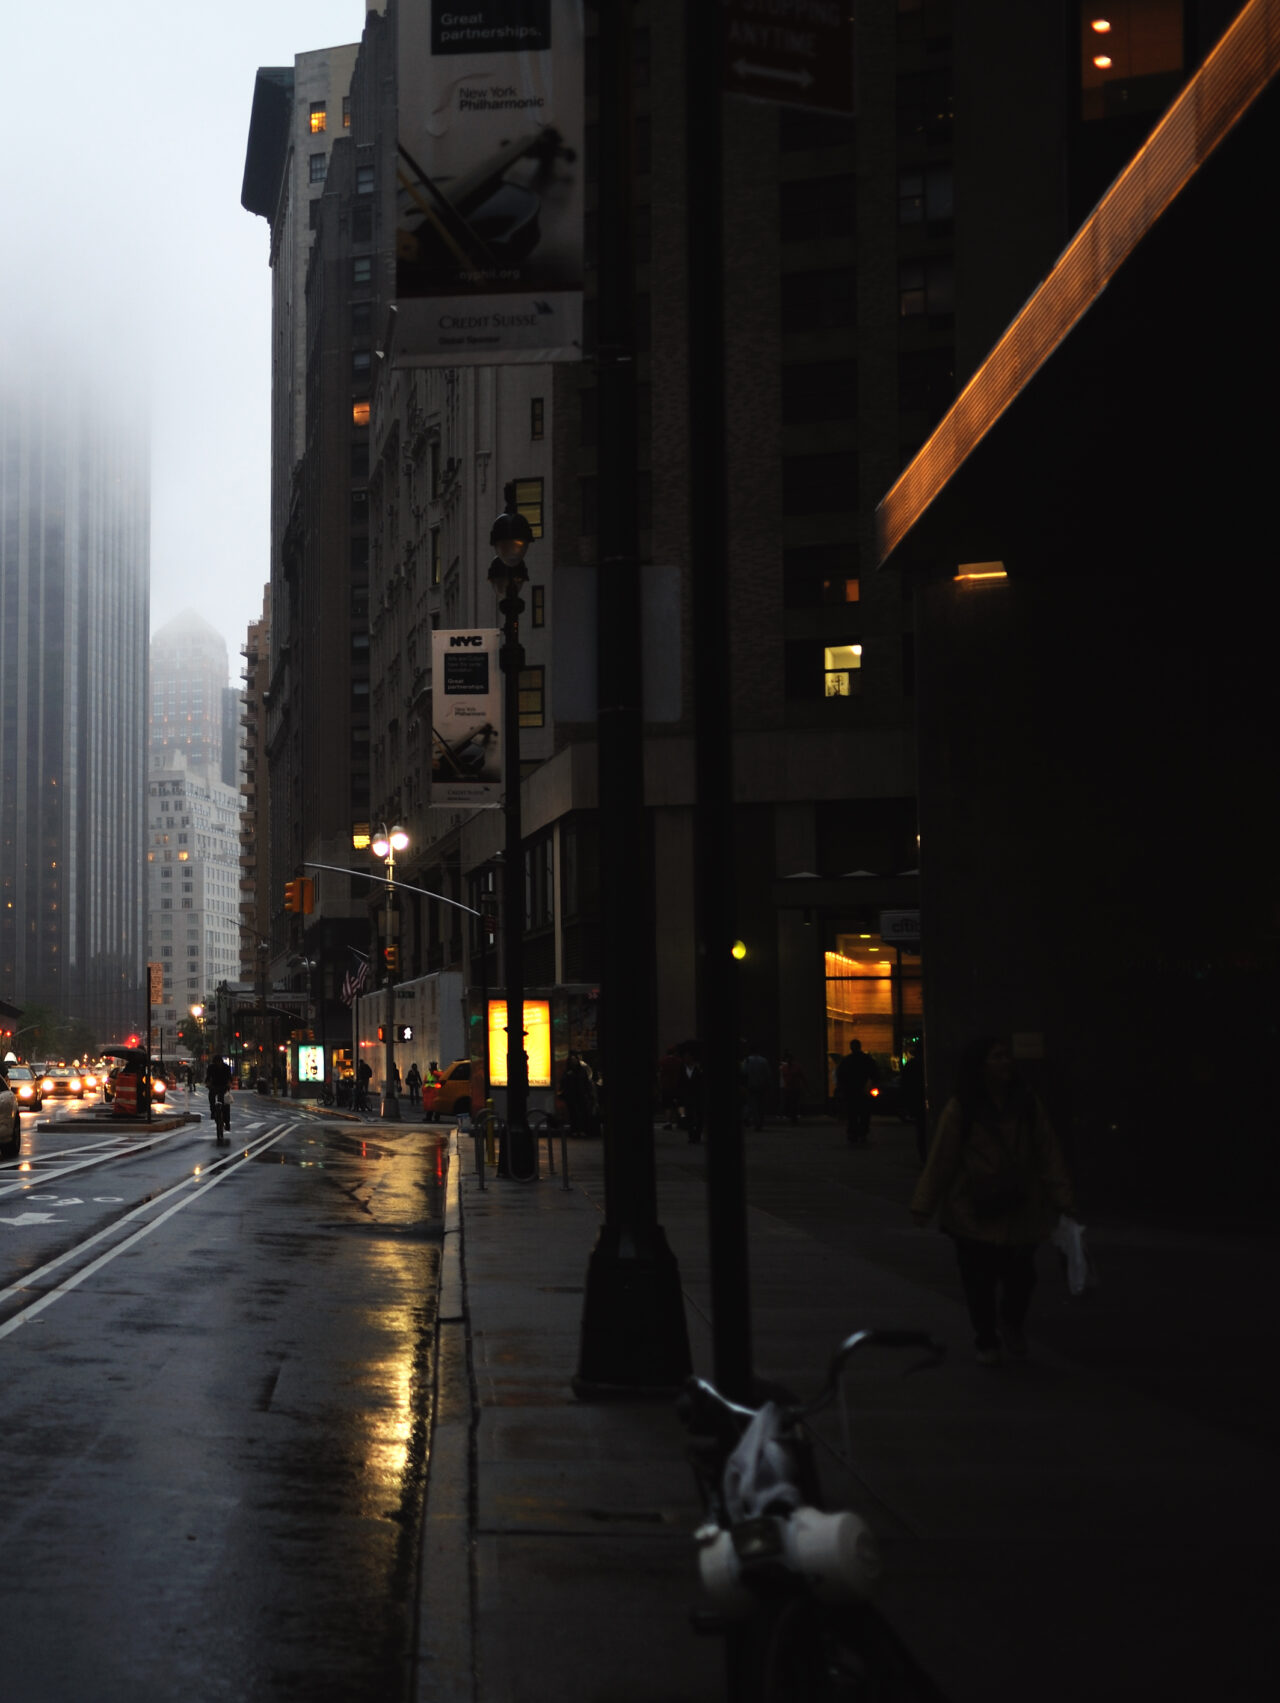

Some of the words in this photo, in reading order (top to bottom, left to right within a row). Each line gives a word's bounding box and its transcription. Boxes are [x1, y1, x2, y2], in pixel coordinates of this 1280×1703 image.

[440, 12, 484, 26] Great
[440, 25, 543, 43] partnerships.
[728, 18, 818, 58] ANYTIME
[459, 87, 488, 98] New
[490, 86, 517, 97] York
[459, 97, 545, 111] Philharmonic
[438, 314, 490, 330] CREDIT
[492, 313, 537, 327] SUISSE
[450, 636, 482, 647] NYC
